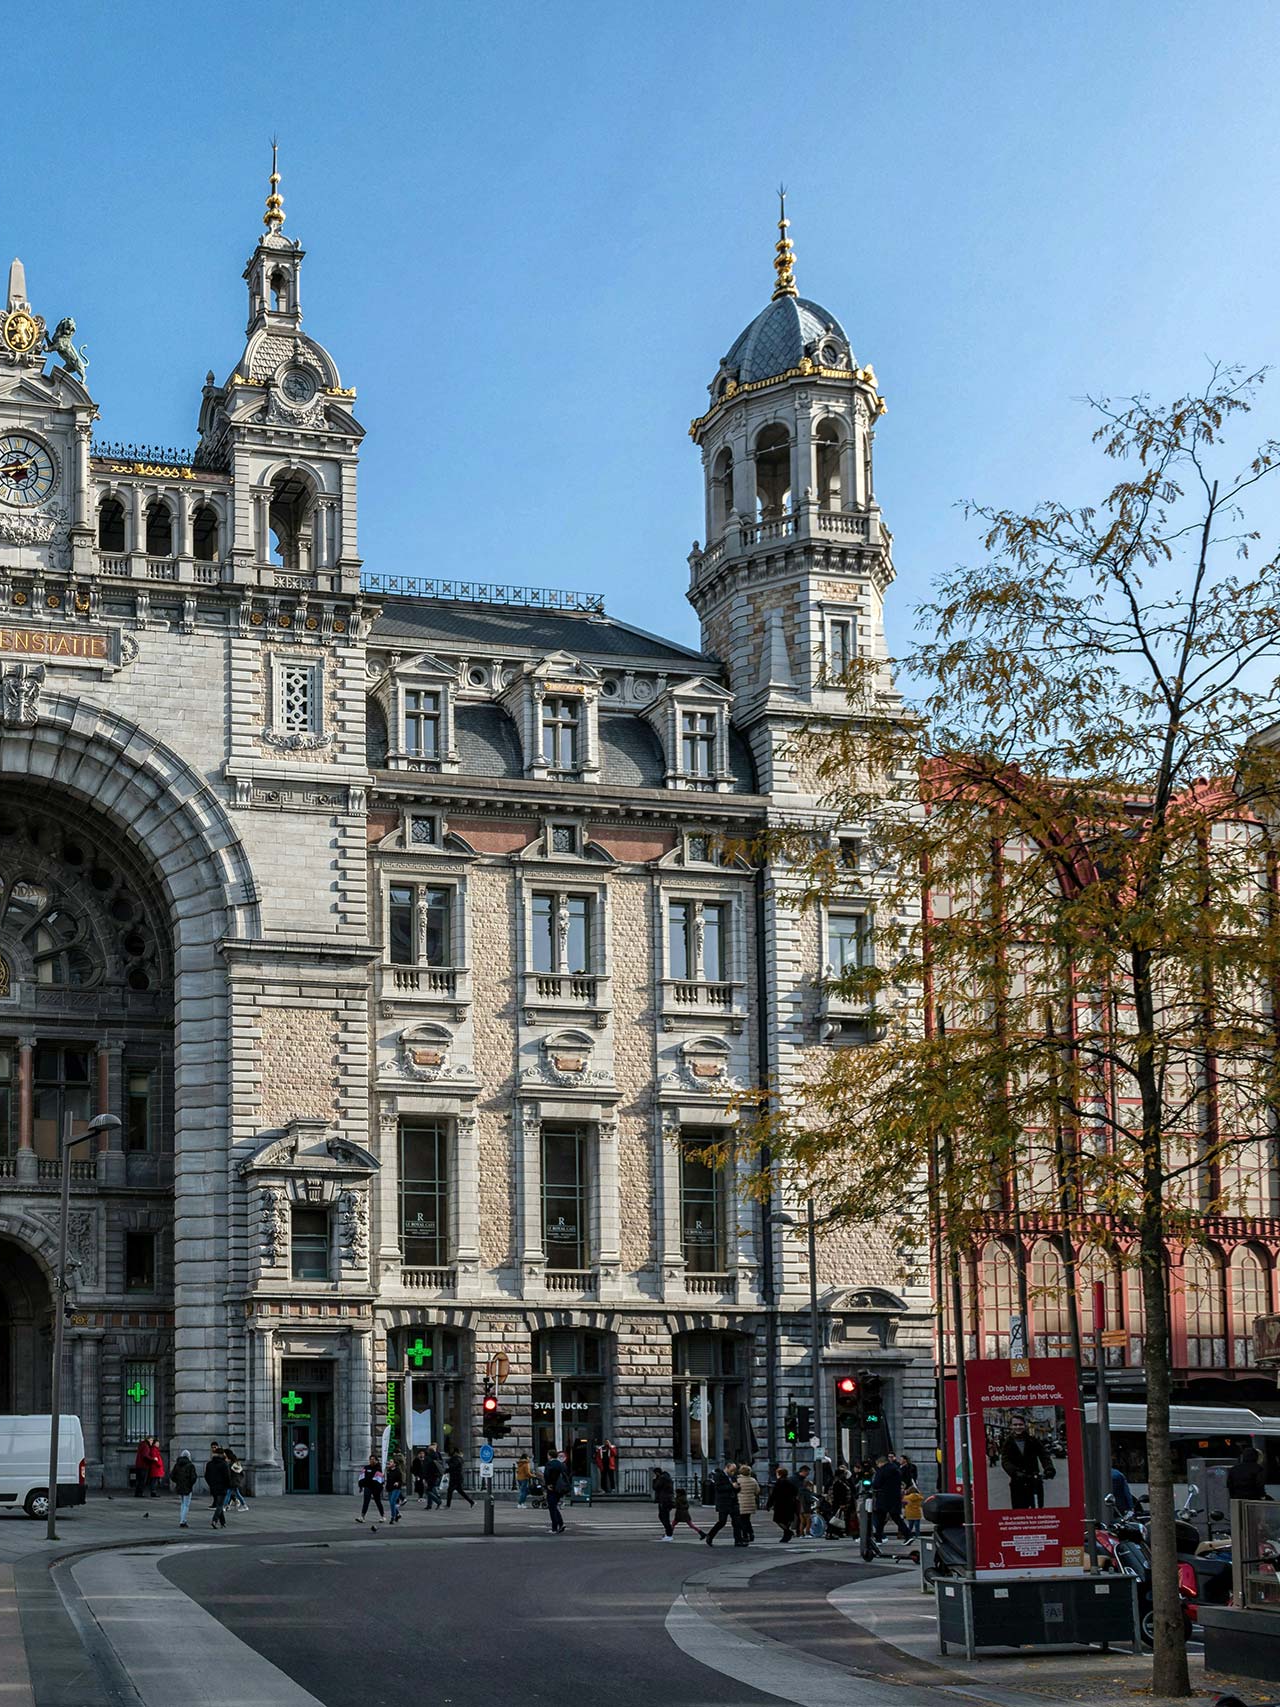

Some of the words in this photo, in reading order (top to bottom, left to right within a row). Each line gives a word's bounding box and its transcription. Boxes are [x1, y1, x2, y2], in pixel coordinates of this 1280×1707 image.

[417, 1212, 424, 1221] R
[558, 1216, 565, 1226] R
[695, 1220, 703, 1229] R
[1016, 1364, 1025, 1373] A
[988, 1385, 1005, 1393] Drop
[1020, 1384, 1026, 1392] je
[1027, 1383, 1056, 1391] deelstep
[991, 1393, 1028, 1401] deelscooter
[385, 1382, 395, 1425] Pharma
